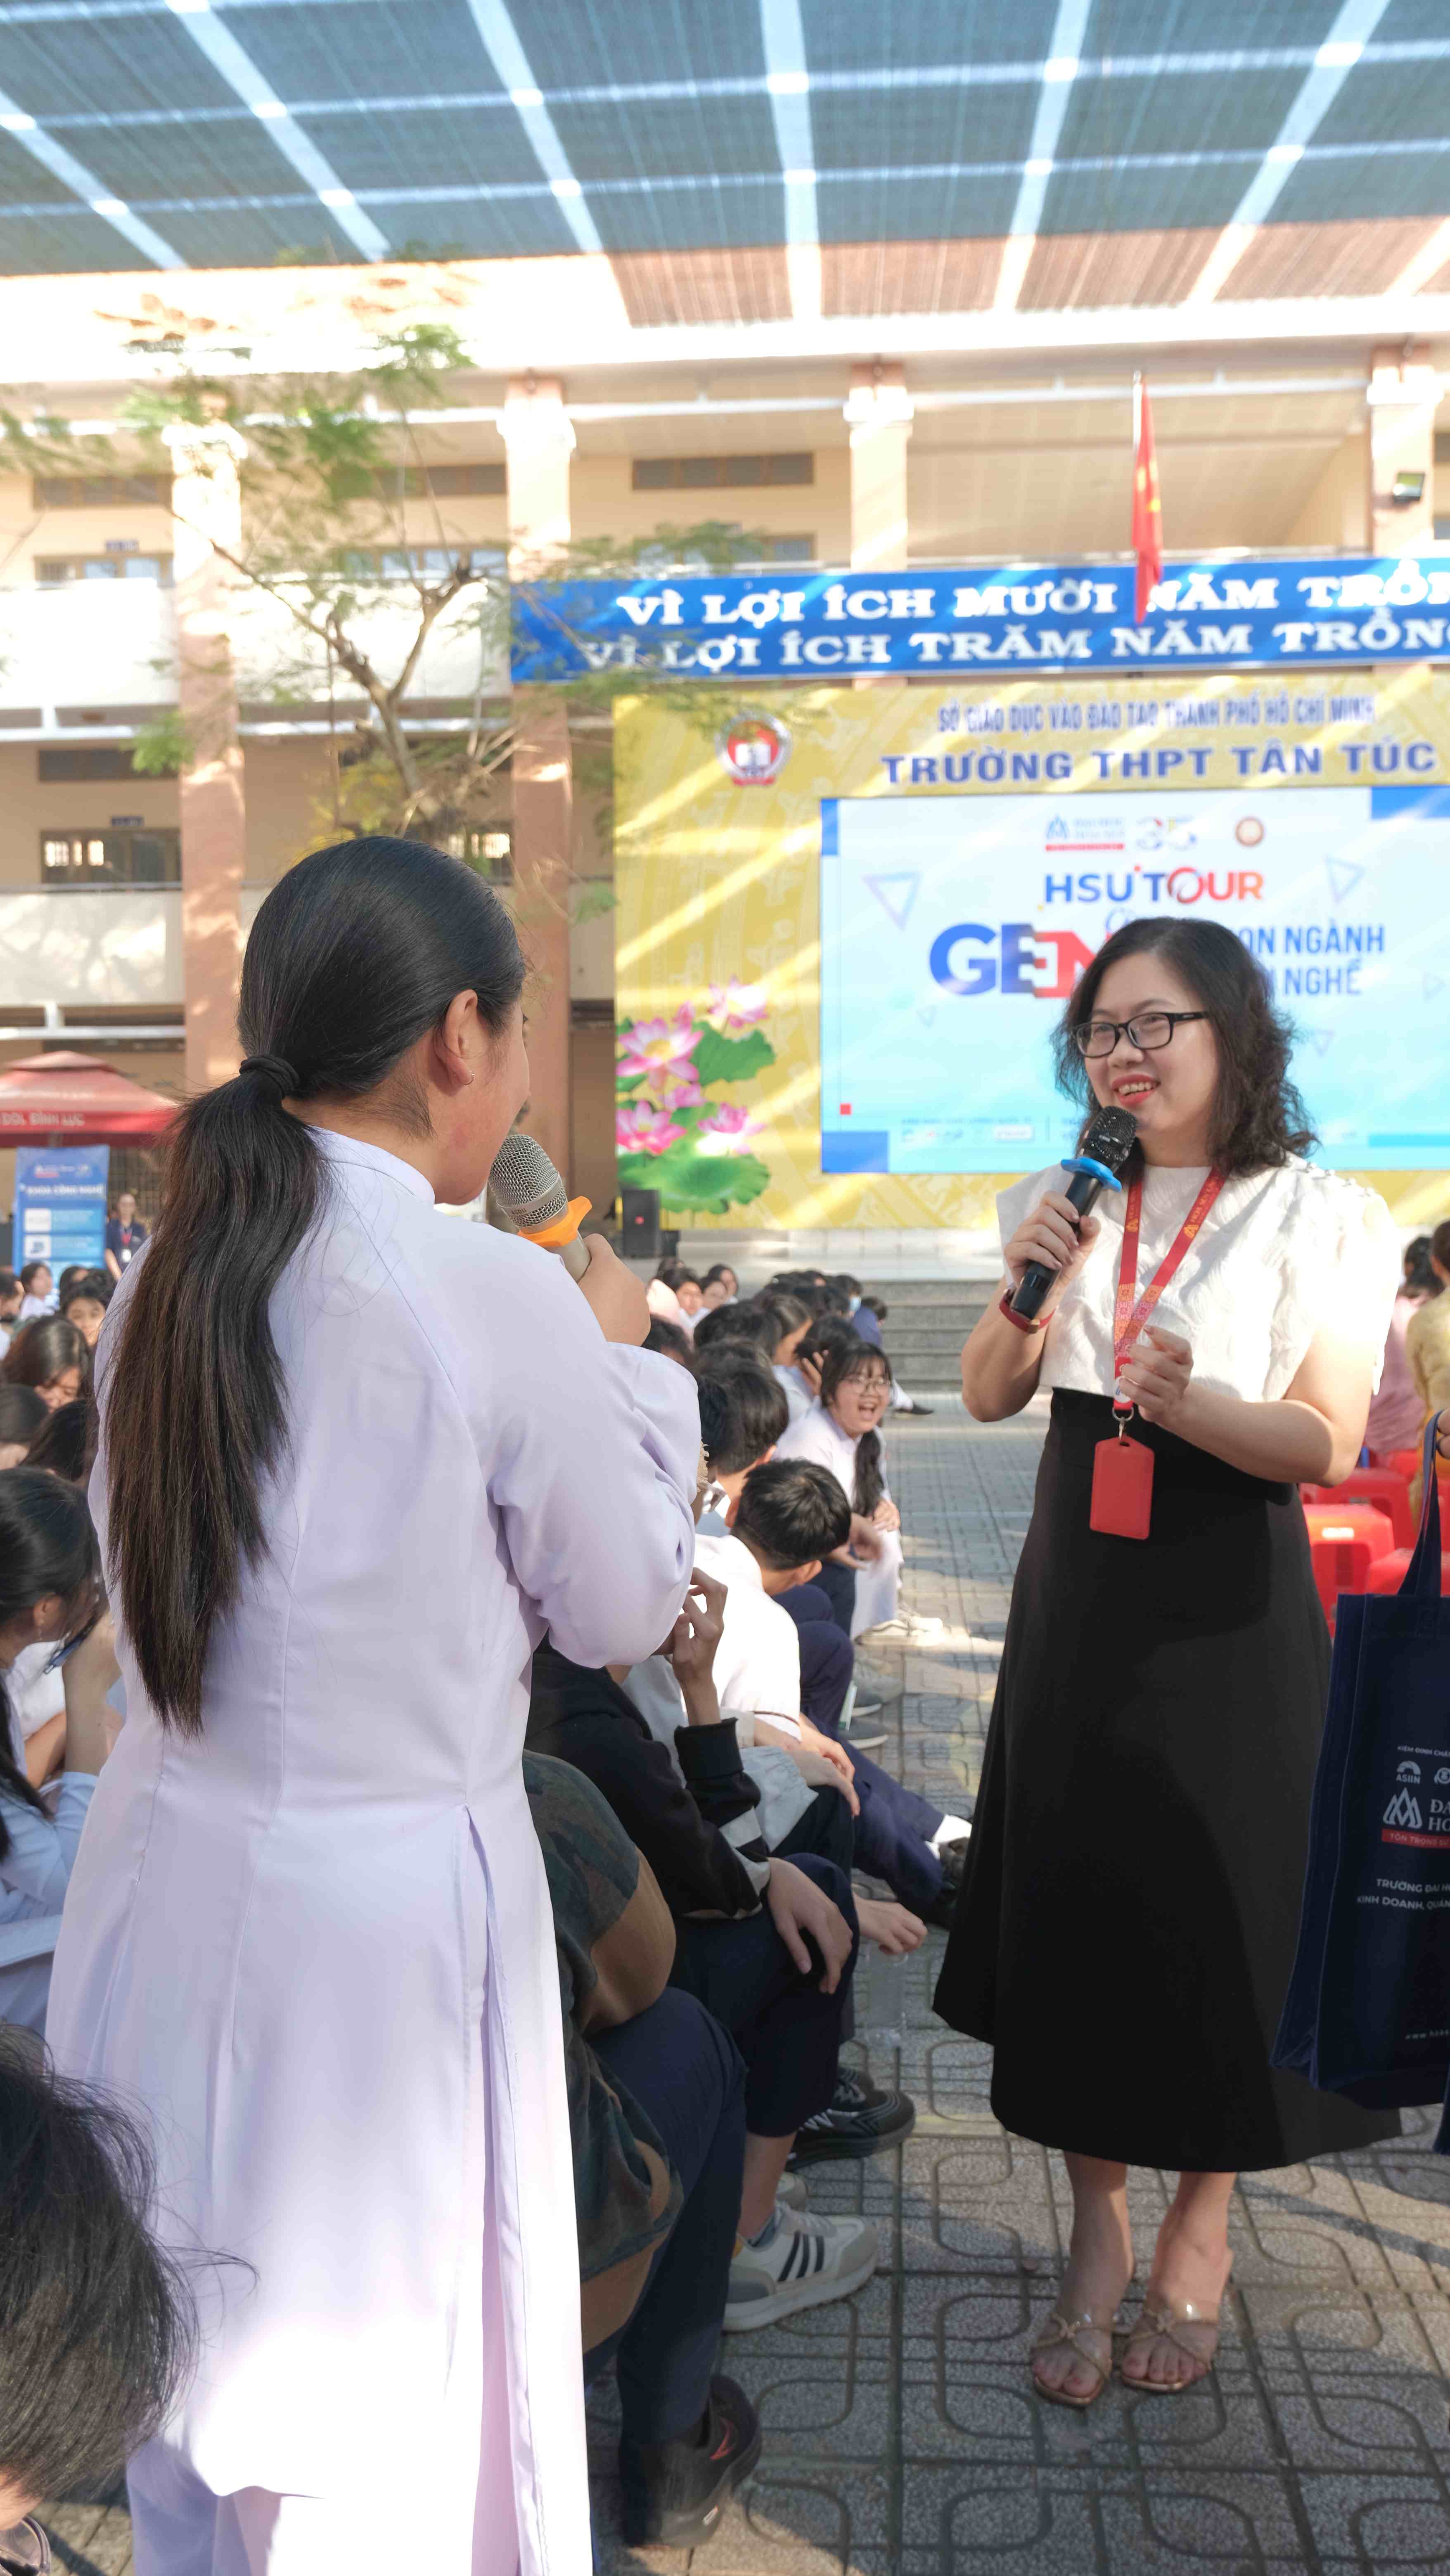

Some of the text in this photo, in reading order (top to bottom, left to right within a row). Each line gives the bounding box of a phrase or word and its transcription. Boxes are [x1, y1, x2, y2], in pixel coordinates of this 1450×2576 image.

[616, 588, 684, 625] VÌ
[701, 589, 805, 628] LỢI
[824, 584, 935, 620] ÍCH
[1146, 573, 1279, 613] NĂM
[663, 633, 761, 673] LỢI
[780, 630, 891, 665] ÍCH
[910, 623, 1092, 661] TRĂM
[1111, 619, 1253, 657] NĂM
[881, 736, 1435, 784] TRƯỜNG THPT TÂN TÚC
[1285, 918, 1384, 953] NGÀNH
[1396, 1774, 1421, 1784] ASIIN
